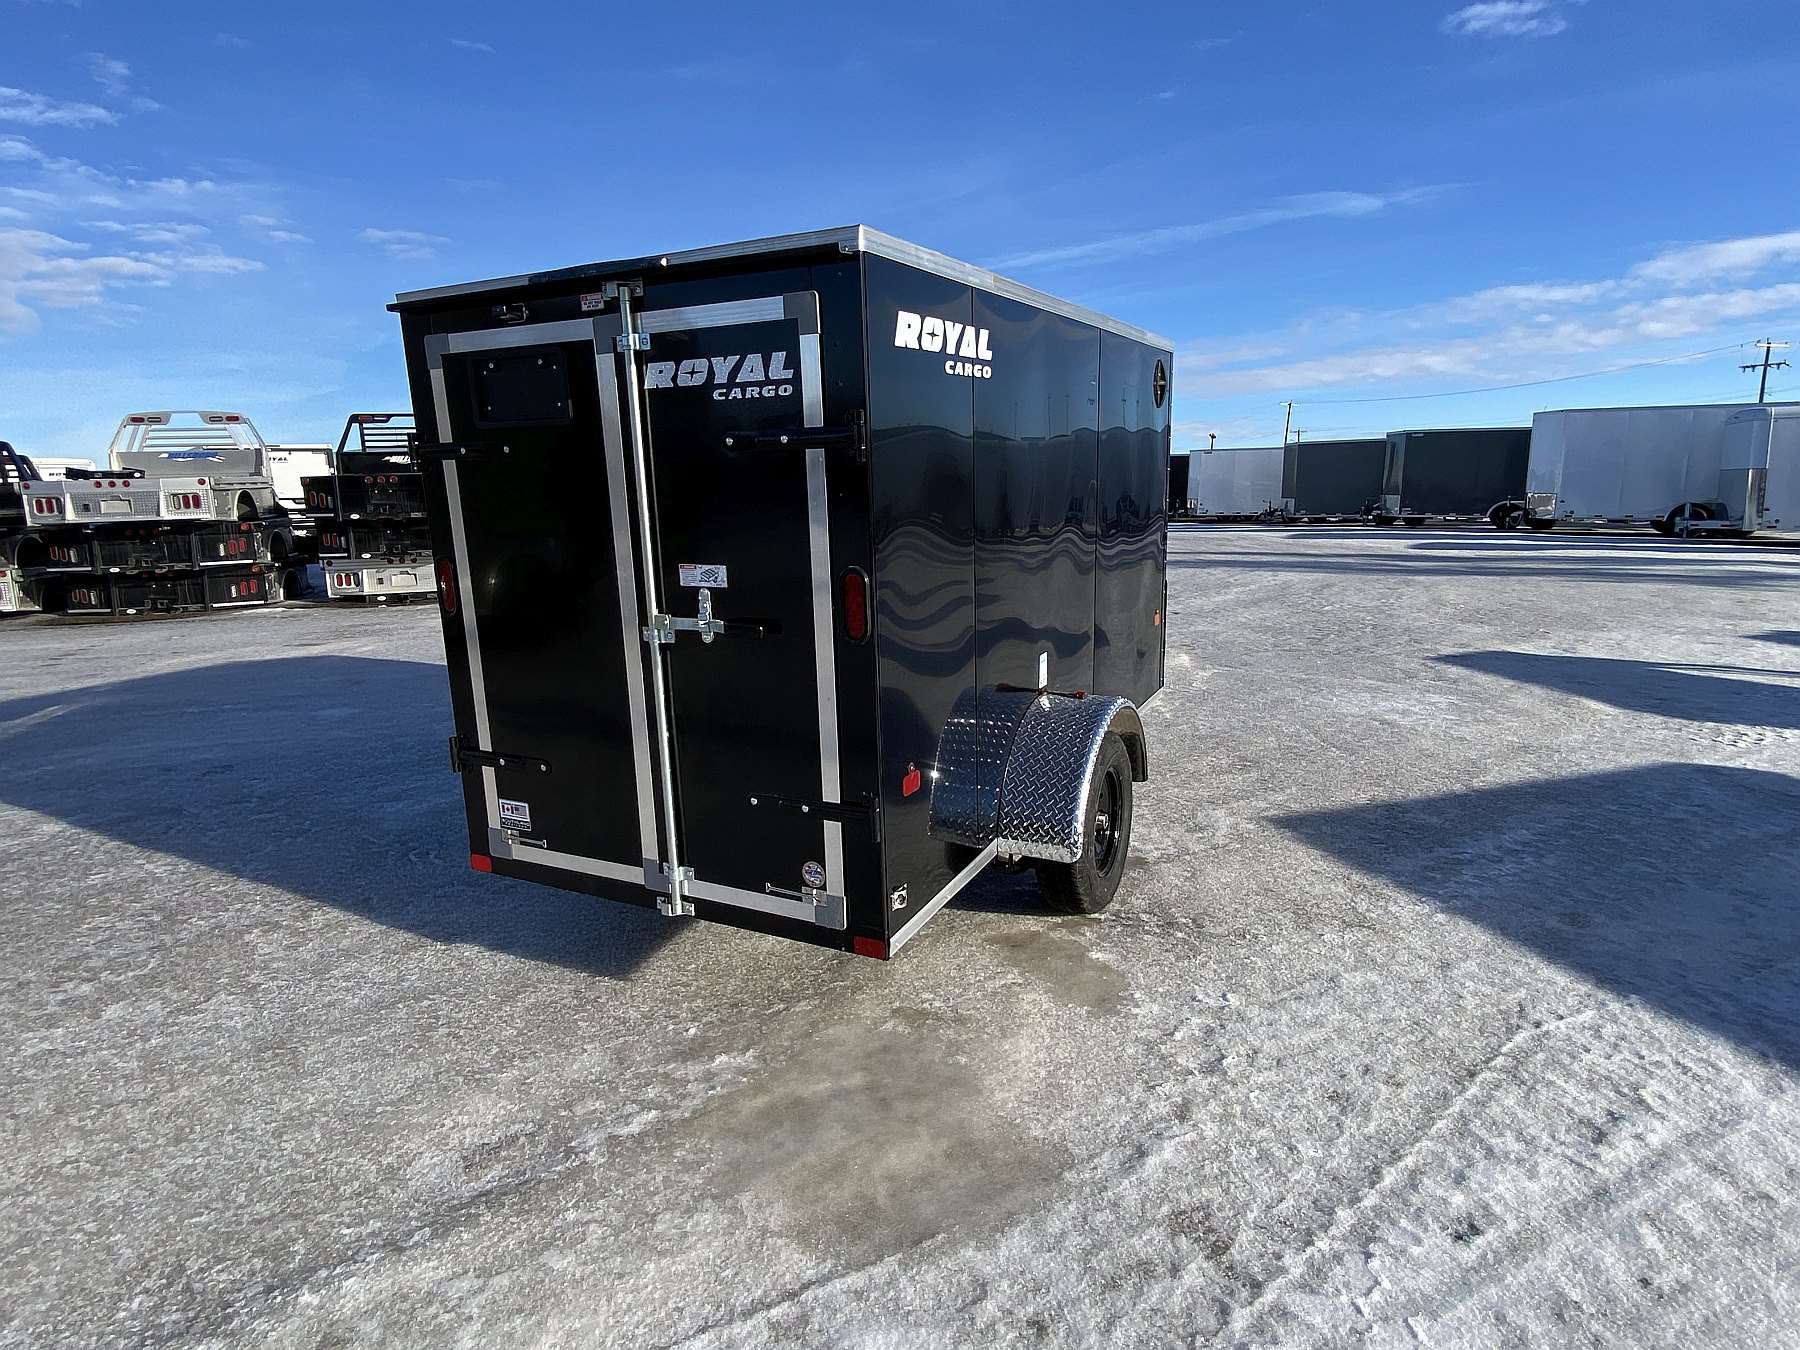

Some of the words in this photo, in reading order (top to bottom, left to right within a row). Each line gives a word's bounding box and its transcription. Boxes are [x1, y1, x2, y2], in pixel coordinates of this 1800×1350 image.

[894, 310, 993, 361] ROYAL
[644, 351, 794, 389] ROYAL
[945, 360, 992, 379] CARGO
[712, 384, 793, 400] CARGO
